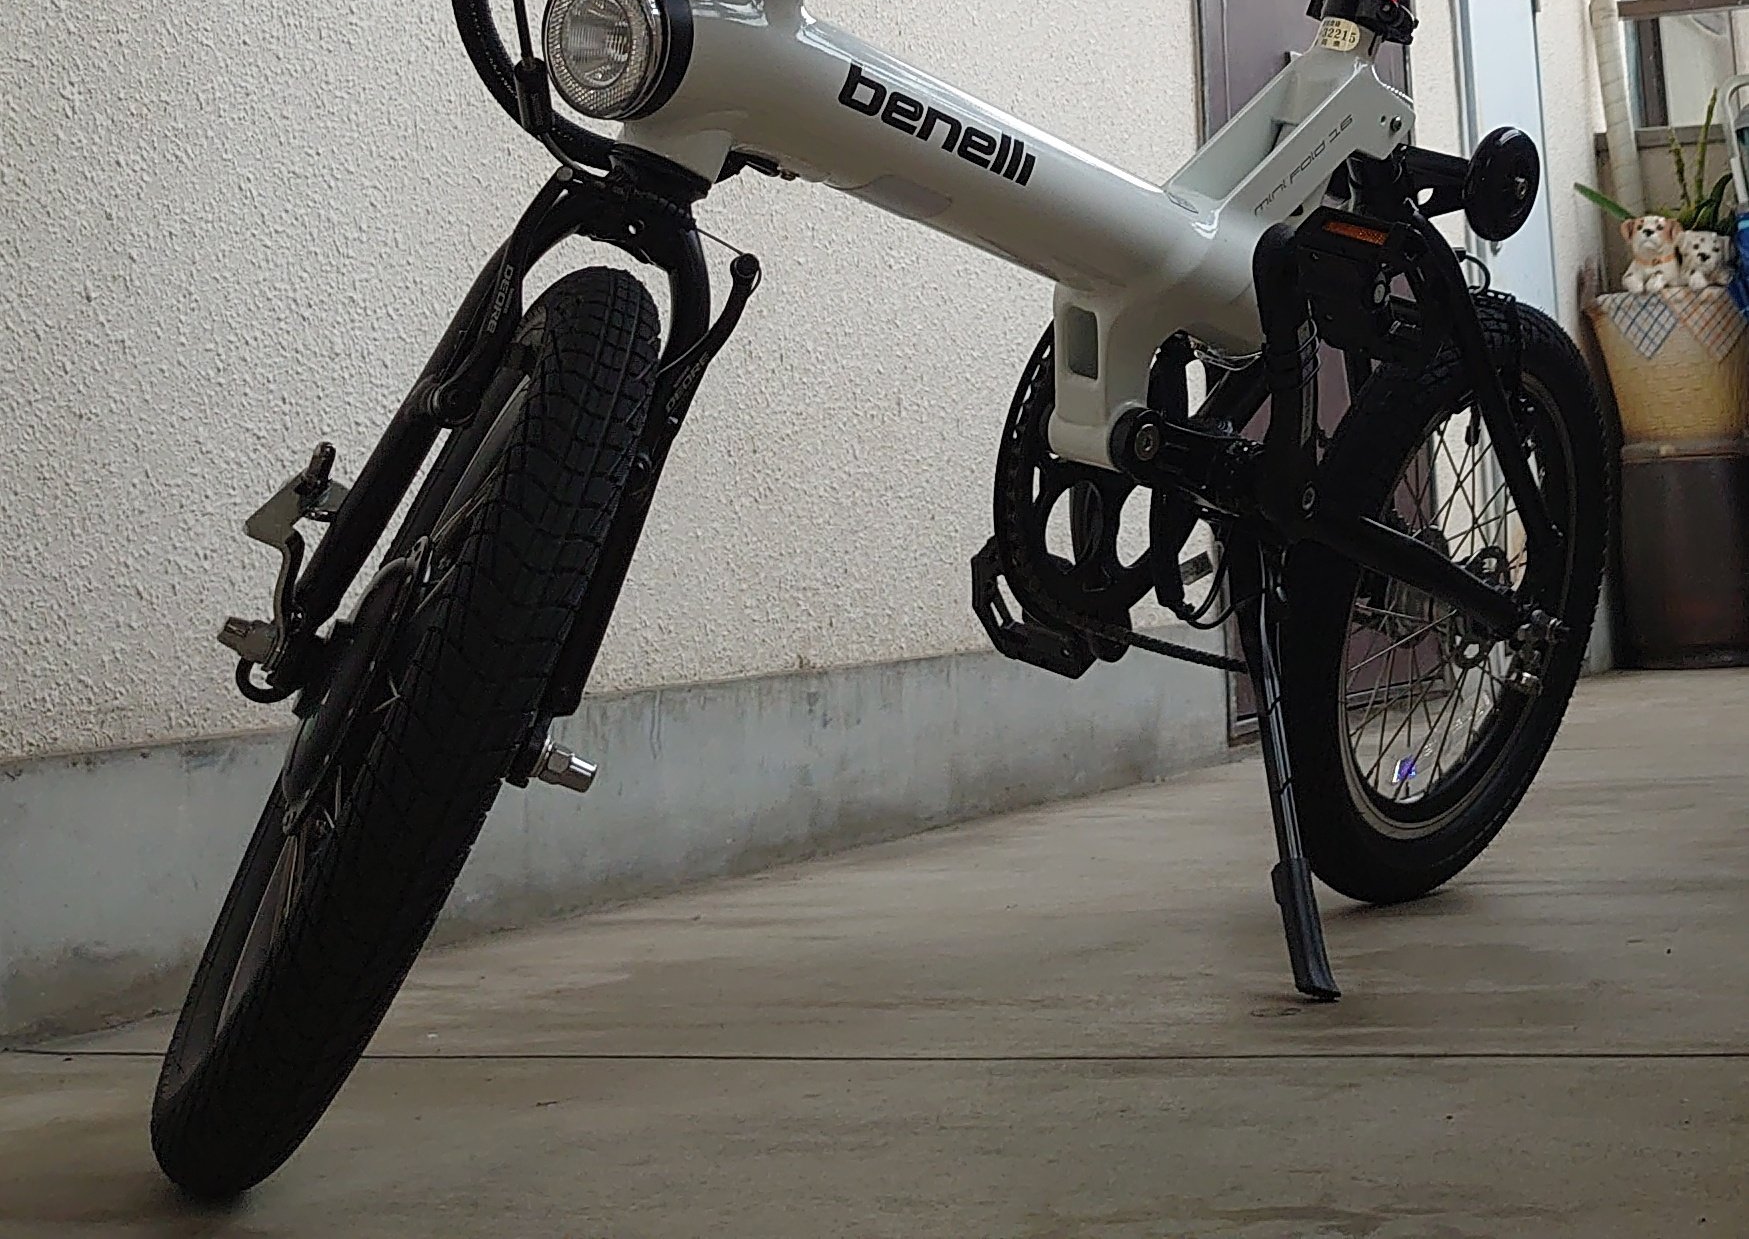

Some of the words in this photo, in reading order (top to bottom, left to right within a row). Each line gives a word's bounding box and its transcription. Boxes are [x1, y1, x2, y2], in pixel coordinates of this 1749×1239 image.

[837, 62, 1037, 187] benelli
[1253, 179, 1287, 217] mini
[1328, 113, 1353, 144] 16
[486, 263, 515, 334] DEORE
